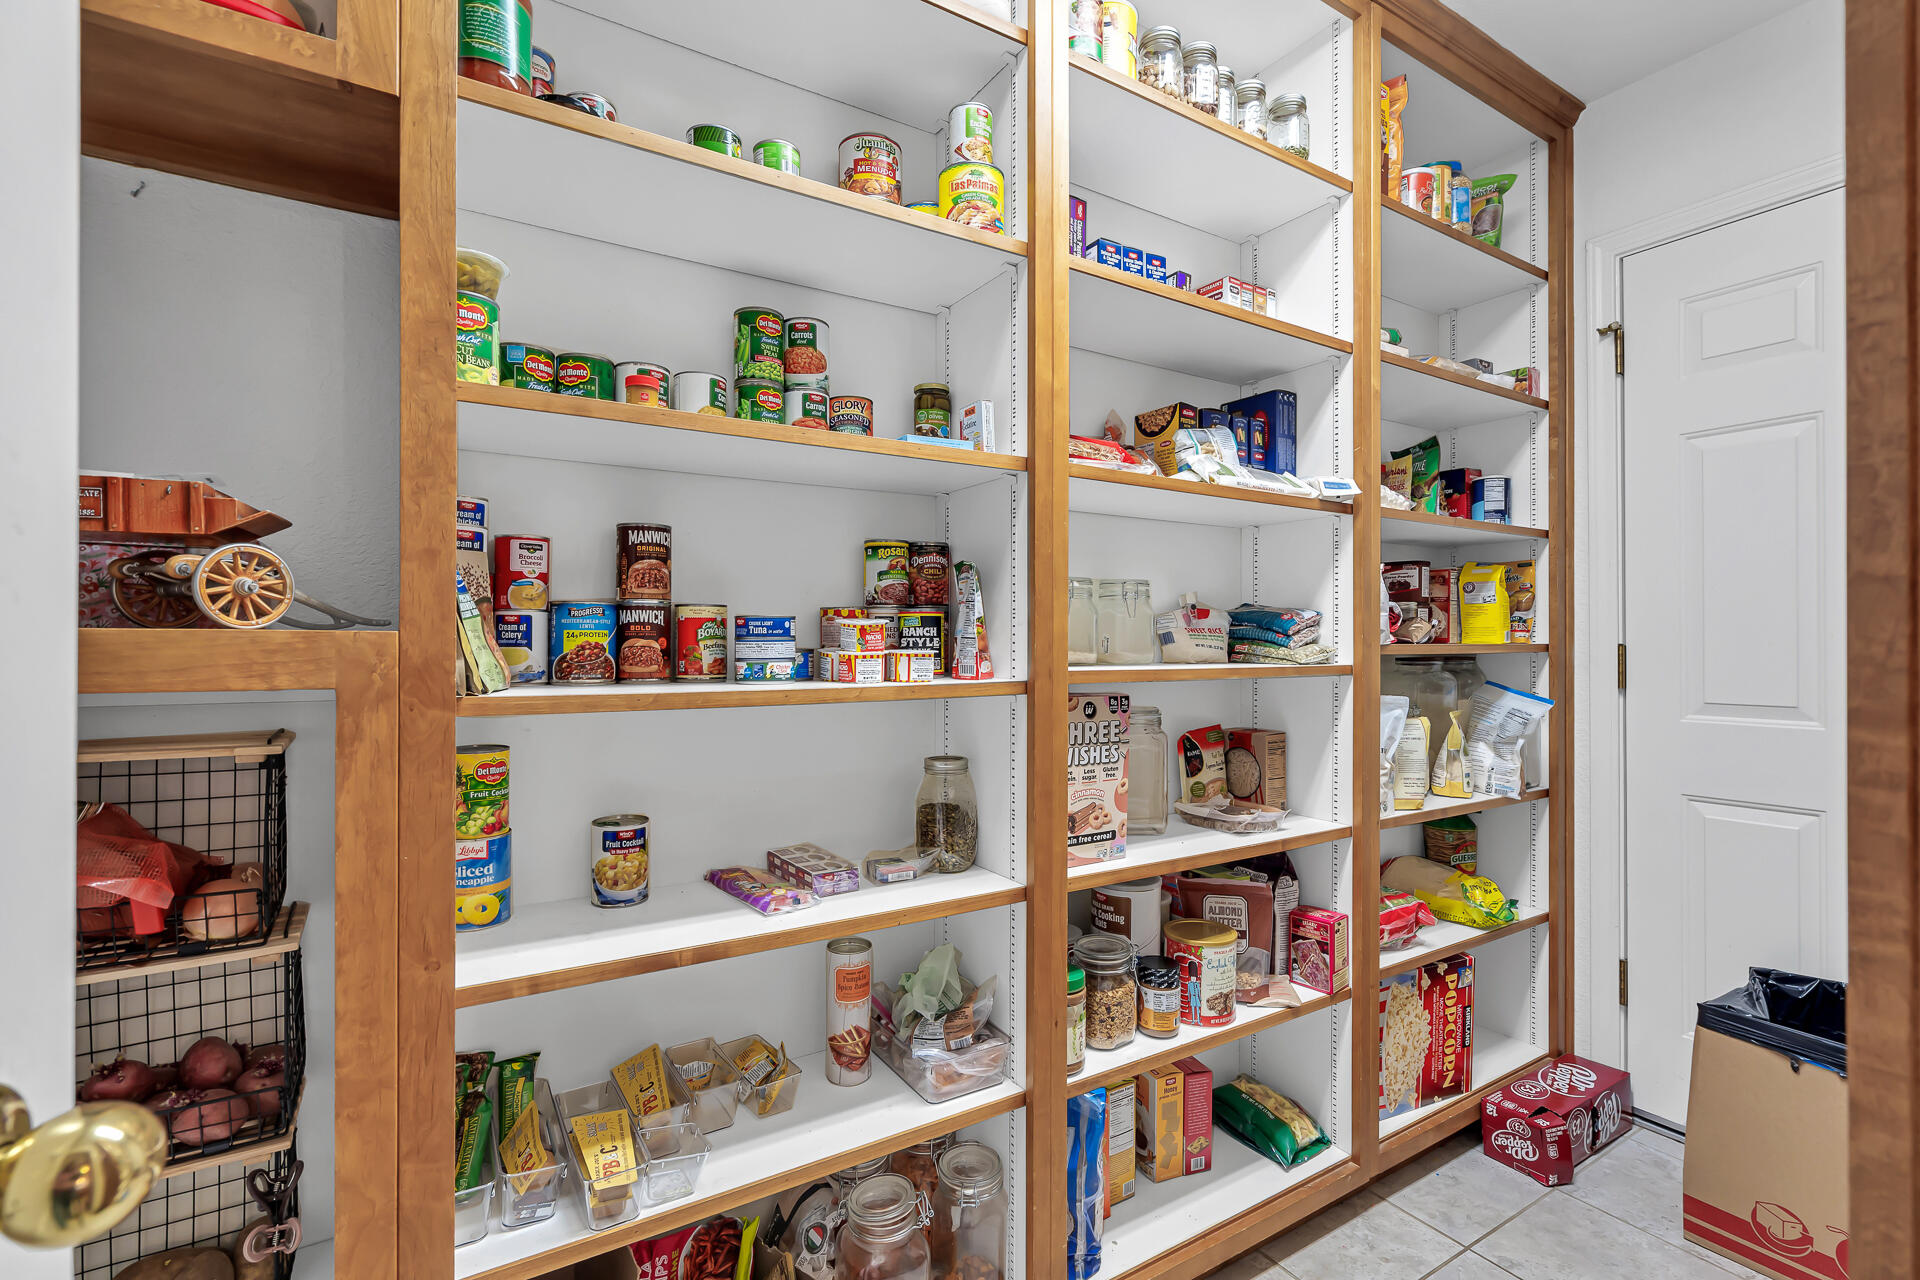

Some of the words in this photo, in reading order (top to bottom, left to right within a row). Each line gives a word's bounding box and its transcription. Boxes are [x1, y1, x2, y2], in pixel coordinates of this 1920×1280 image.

[854, 137, 896, 155] Juanita's
[857, 166, 894, 177] MENUDO
[951, 180, 965, 193] Las
[966, 178, 999, 194] Palmas
[458, 308, 485, 323] Monte
[791, 331, 813, 340] Carrots
[760, 342, 780, 352] SWEET
[764, 350, 778, 358] PEAS
[466, 355, 490, 369] BEANS
[527, 360, 538, 370] Del
[559, 368, 567, 376] Del
[567, 368, 588, 376] Monte
[759, 394, 768, 402] Del
[806, 402, 826, 411] Carrots
[832, 400, 868, 414] GLORY
[830, 414, 870, 427] SEASONED
[456, 511, 474, 520] ream
[476, 512, 482, 520] of
[628, 530, 671, 548] MANWICH
[456, 540, 472, 549] eam
[474, 540, 480, 549] of
[637, 545, 667, 553] ORIGINAL
[570, 607, 603, 617] PROGRESSO
[620, 610, 664, 626] MANWICH
[498, 624, 518, 632] Cream
[520, 624, 526, 632] of
[702, 620, 716, 629] Chef
[749, 626, 767, 634] Tuna
[902, 627, 937, 637] RANCH
[502, 631, 522, 640] Celery
[900, 637, 940, 648] STYLE
[1110, 698, 1117, 706] 8g
[1121, 698, 1128, 706] 3g
[1069, 720, 1120, 745] HREE
[477, 768, 488, 776] Del
[490, 766, 507, 774] Monte
[470, 790, 489, 798] Fruit
[1071, 788, 1106, 800] cinnamon
[606, 840, 621, 848] Fruit
[622, 838, 644, 848] Cocktail
[1068, 838, 1078, 846] ain
[1079, 835, 1092, 844] free
[1093, 833, 1112, 842] cereal
[458, 846, 484, 856] Libby's
[456, 863, 494, 878] liced
[456, 874, 495, 886] neapple
[1208, 906, 1242, 917] ALMOND
[1099, 909, 1125, 925] Cooking
[1094, 917, 1108, 929] Oats
[1207, 958, 1227, 972] English
[842, 974, 867, 983] Pumpkin
[1442, 973, 1457, 1089] POPCORN
[1164, 1086, 1178, 1095] Honey
[466, 1116, 480, 1145] NATURE
